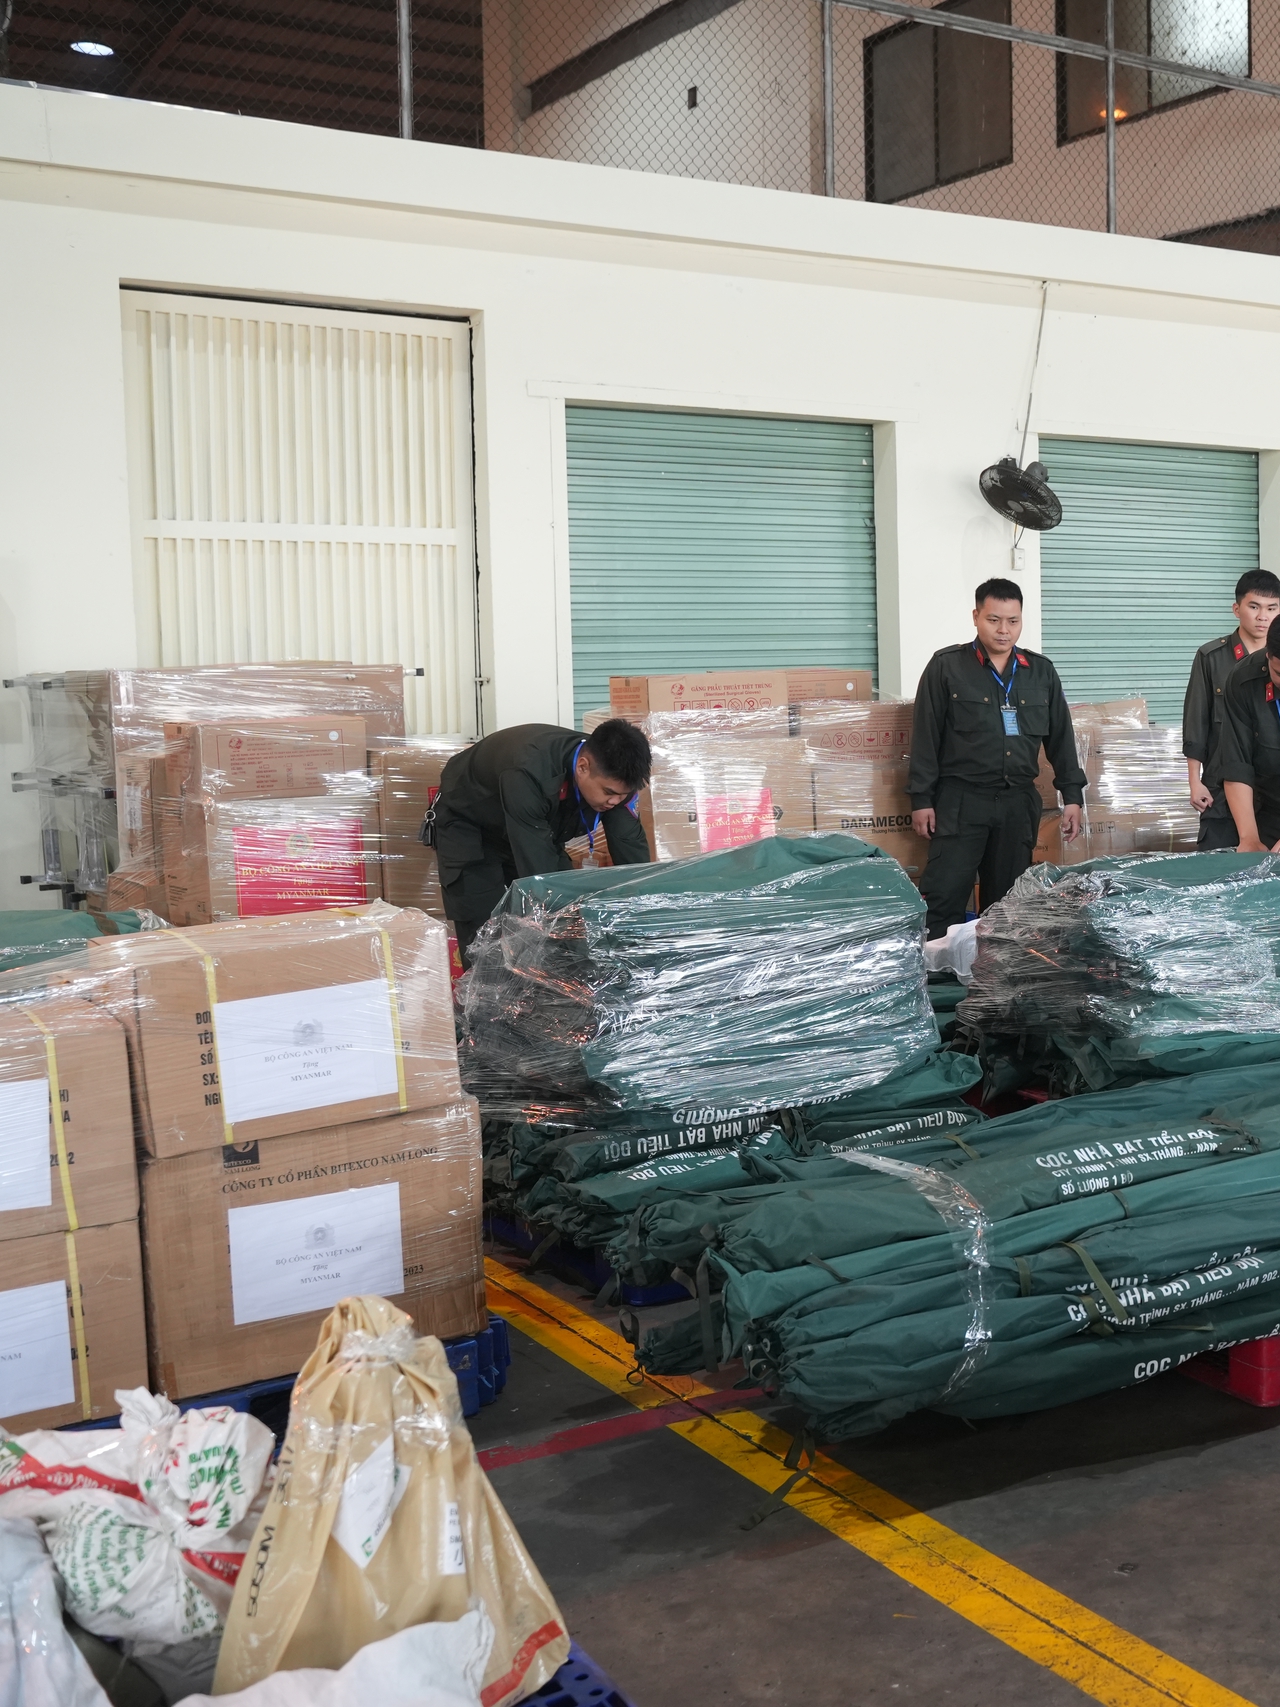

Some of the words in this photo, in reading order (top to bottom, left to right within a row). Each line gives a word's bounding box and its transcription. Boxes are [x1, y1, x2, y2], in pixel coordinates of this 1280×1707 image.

[841, 815, 912, 830] DANAMECO
[264, 1055, 276, 1063] BỘ
[277, 1051, 301, 1061] CÔNG
[302, 1049, 313, 1058] AN
[315, 1045, 335, 1055] VIỆT
[334, 1042, 353, 1051] NAM
[290, 1070, 332, 1083] MYANMAR
[1073, 1141, 1113, 1163] NHÀ
[222, 1177, 256, 1194] CÔNG
[258, 1176, 275, 1188] TY
[277, 1169, 294, 1184] CỔ
[297, 1165, 329, 1181] PHẦN
[330, 1157, 379, 1175] BITEXCO
[381, 1152, 406, 1166] NAM
[408, 1146, 438, 1160] LONG
[224, 1159, 251, 1167] BITEXCO
[1072, 1163, 1108, 1175] THANH
[224, 1167, 240, 1175] NAM
[1061, 1179, 1075, 1195] SỐ
[1112, 1174, 1117, 1186] 1
[275, 1257, 287, 1266] BỘ
[289, 1253, 311, 1263] CÔNG
[313, 1252, 324, 1260] AN
[325, 1248, 344, 1258] VIỆT
[344, 1245, 362, 1254] NAM
[300, 1272, 341, 1285] MYANMAR
